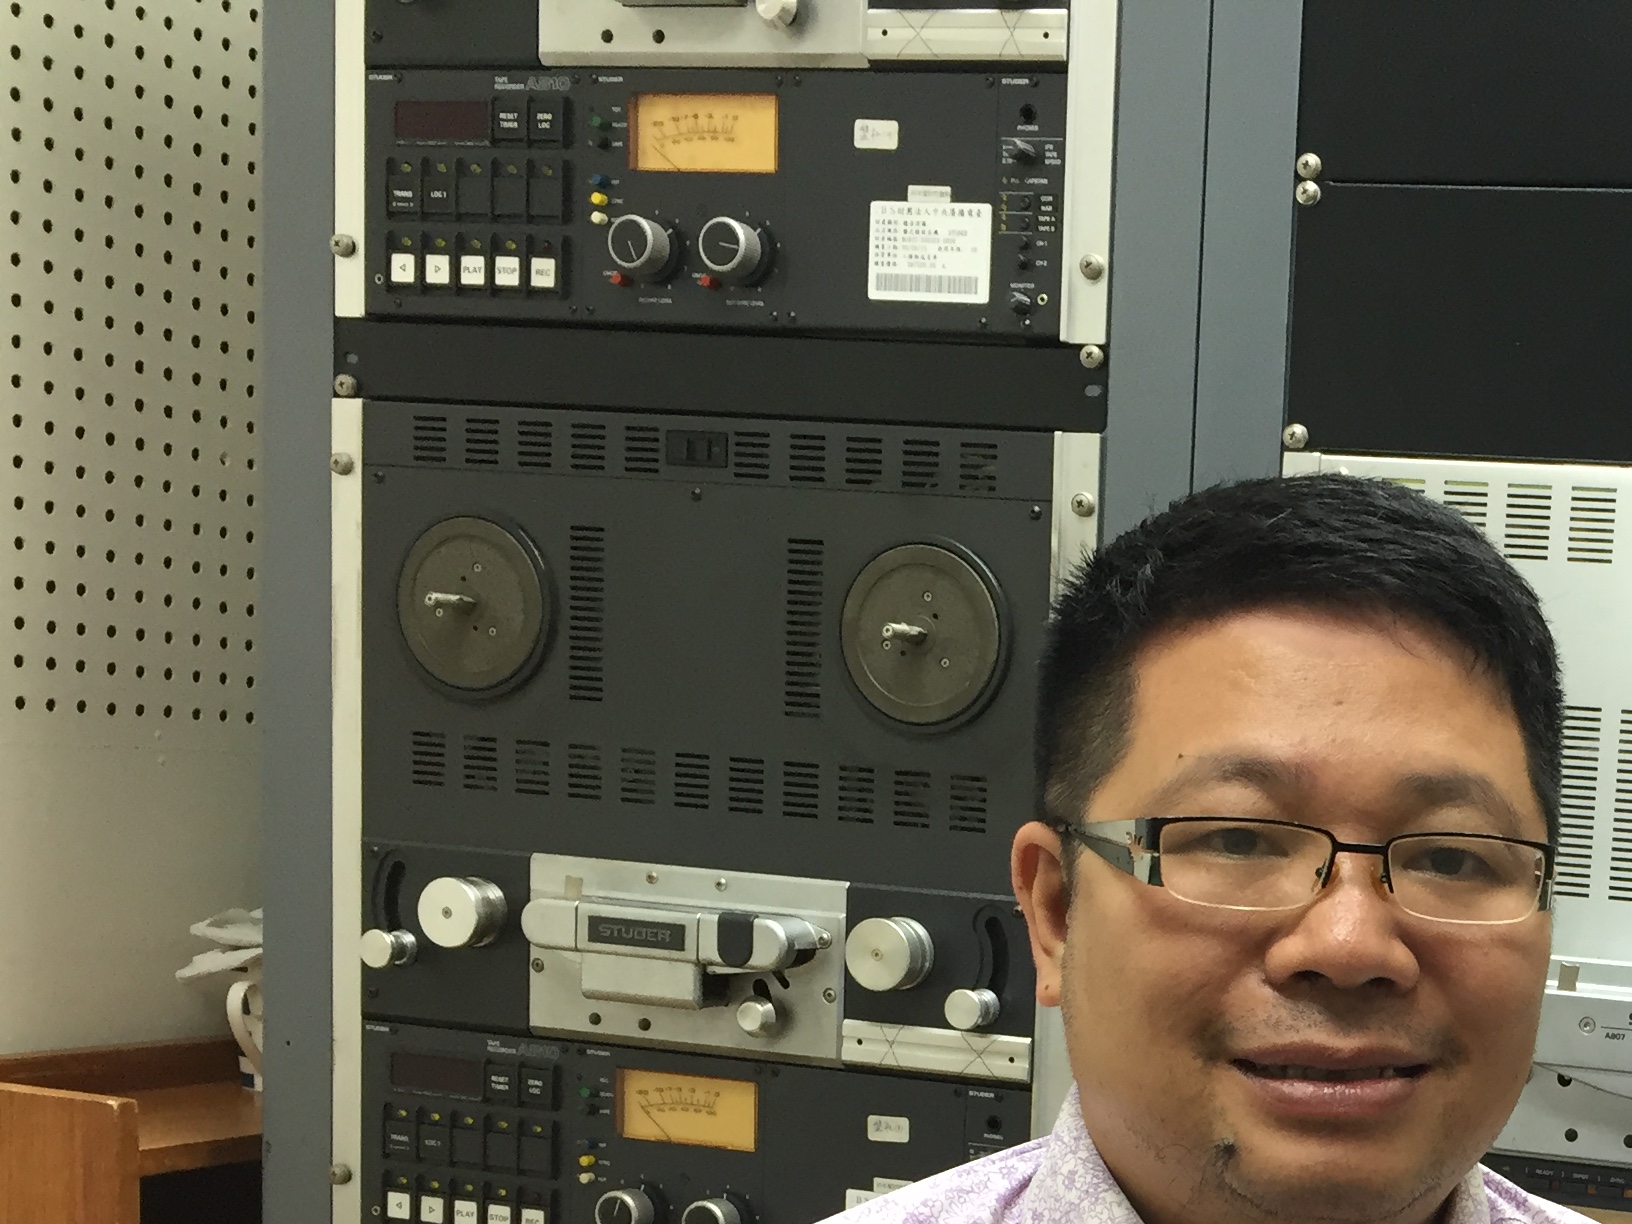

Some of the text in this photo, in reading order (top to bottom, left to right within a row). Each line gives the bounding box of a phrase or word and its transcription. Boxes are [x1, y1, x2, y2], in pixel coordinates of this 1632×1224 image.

[462, 266, 482, 274] PLAY
[496, 266, 517, 275] STOP
[535, 268, 550, 277] REC
[598, 923, 672, 942] STUDER
[1604, 1032, 1626, 1041] A807
[456, 1209, 475, 1218] PLAY
[489, 1214, 509, 1223] STOP
